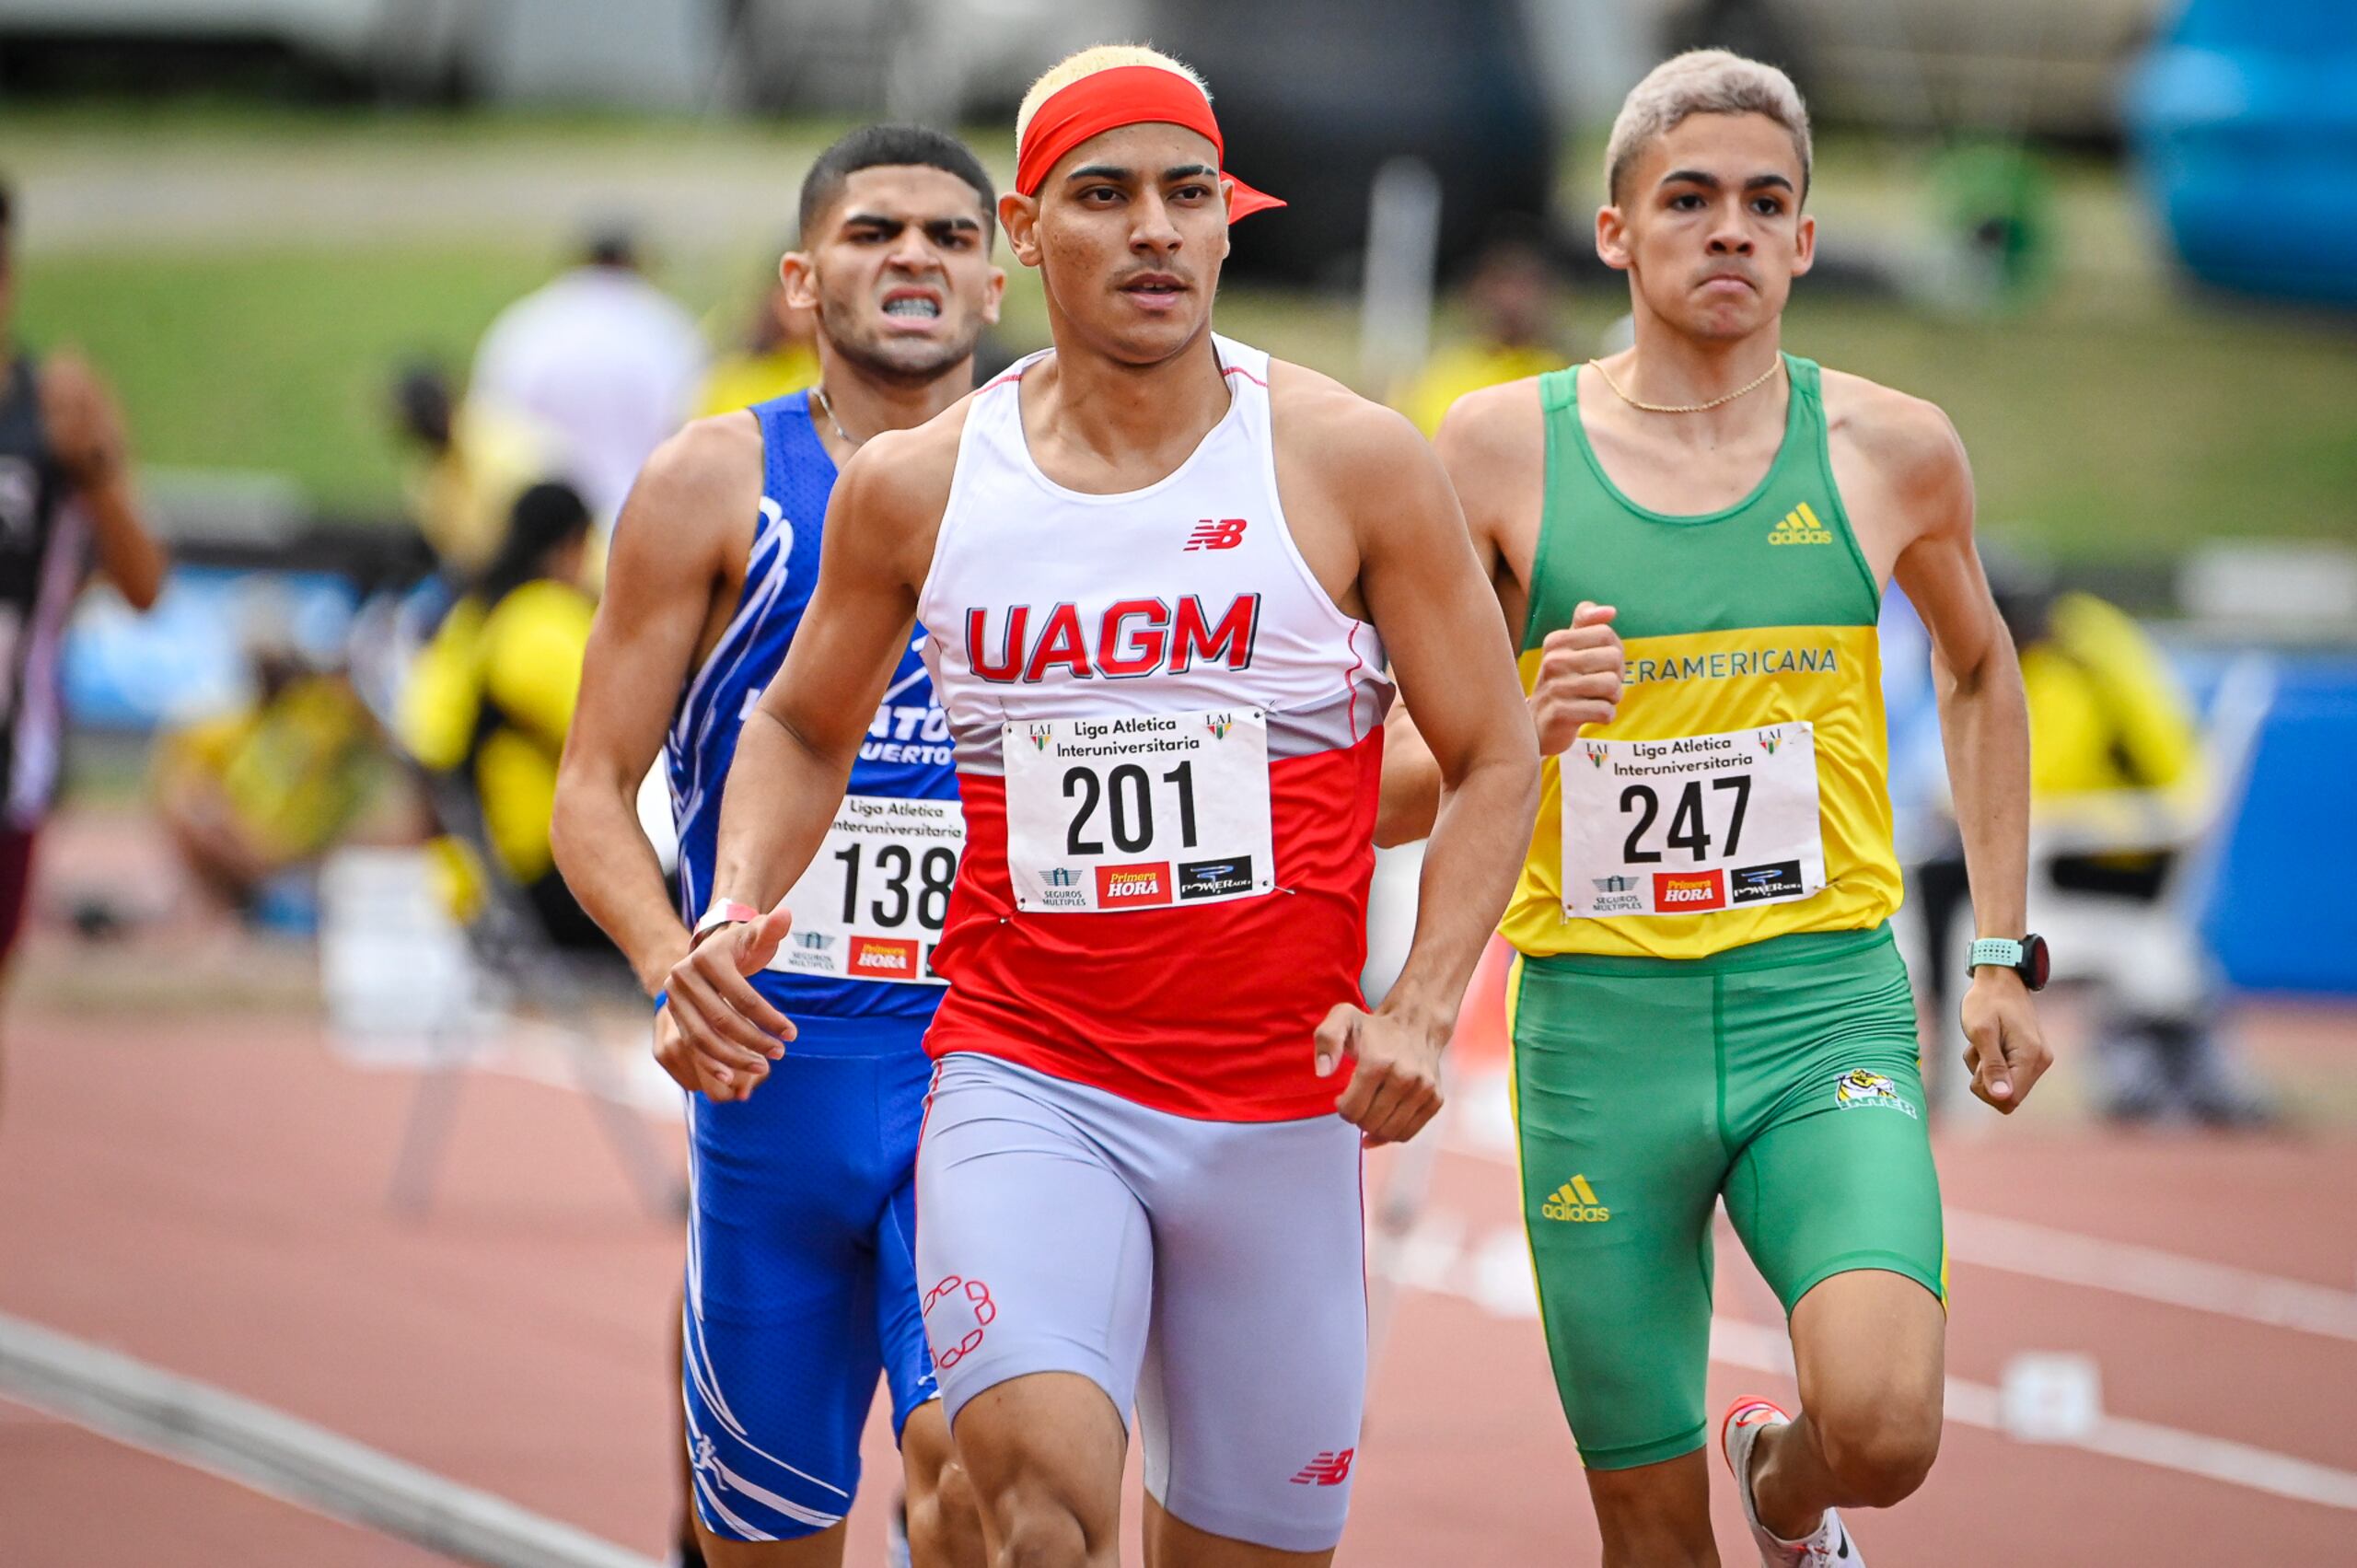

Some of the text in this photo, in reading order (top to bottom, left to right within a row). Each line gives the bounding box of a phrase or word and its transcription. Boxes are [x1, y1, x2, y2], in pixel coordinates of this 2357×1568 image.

[1768, 528, 1833, 545] adidas
[967, 592, 1261, 684] UAGM
[1621, 648, 1838, 686] ERAMERICANA
[1074, 717, 1177, 739] Liga Atletica
[859, 741, 952, 766] UERTO
[1057, 736, 1201, 758] Interuniversitaria
[1632, 738, 1732, 759] Liga Atletica
[1614, 753, 1754, 776] Interuniversitaria
[850, 799, 944, 819] Liga Atletica
[1062, 760, 1198, 856] 201
[832, 819, 962, 839] nteruniversitaria
[1620, 774, 1752, 865] 247
[834, 842, 957, 931] 138
[1109, 872, 1157, 884] Primera
[1044, 890, 1083, 900] SEGUROS
[1107, 880, 1159, 897] HORA
[1664, 887, 1713, 902] HORA
[1596, 895, 1639, 904] SEGUROS
[857, 952, 907, 970] HORA
[1541, 1202, 1610, 1222] adidas
